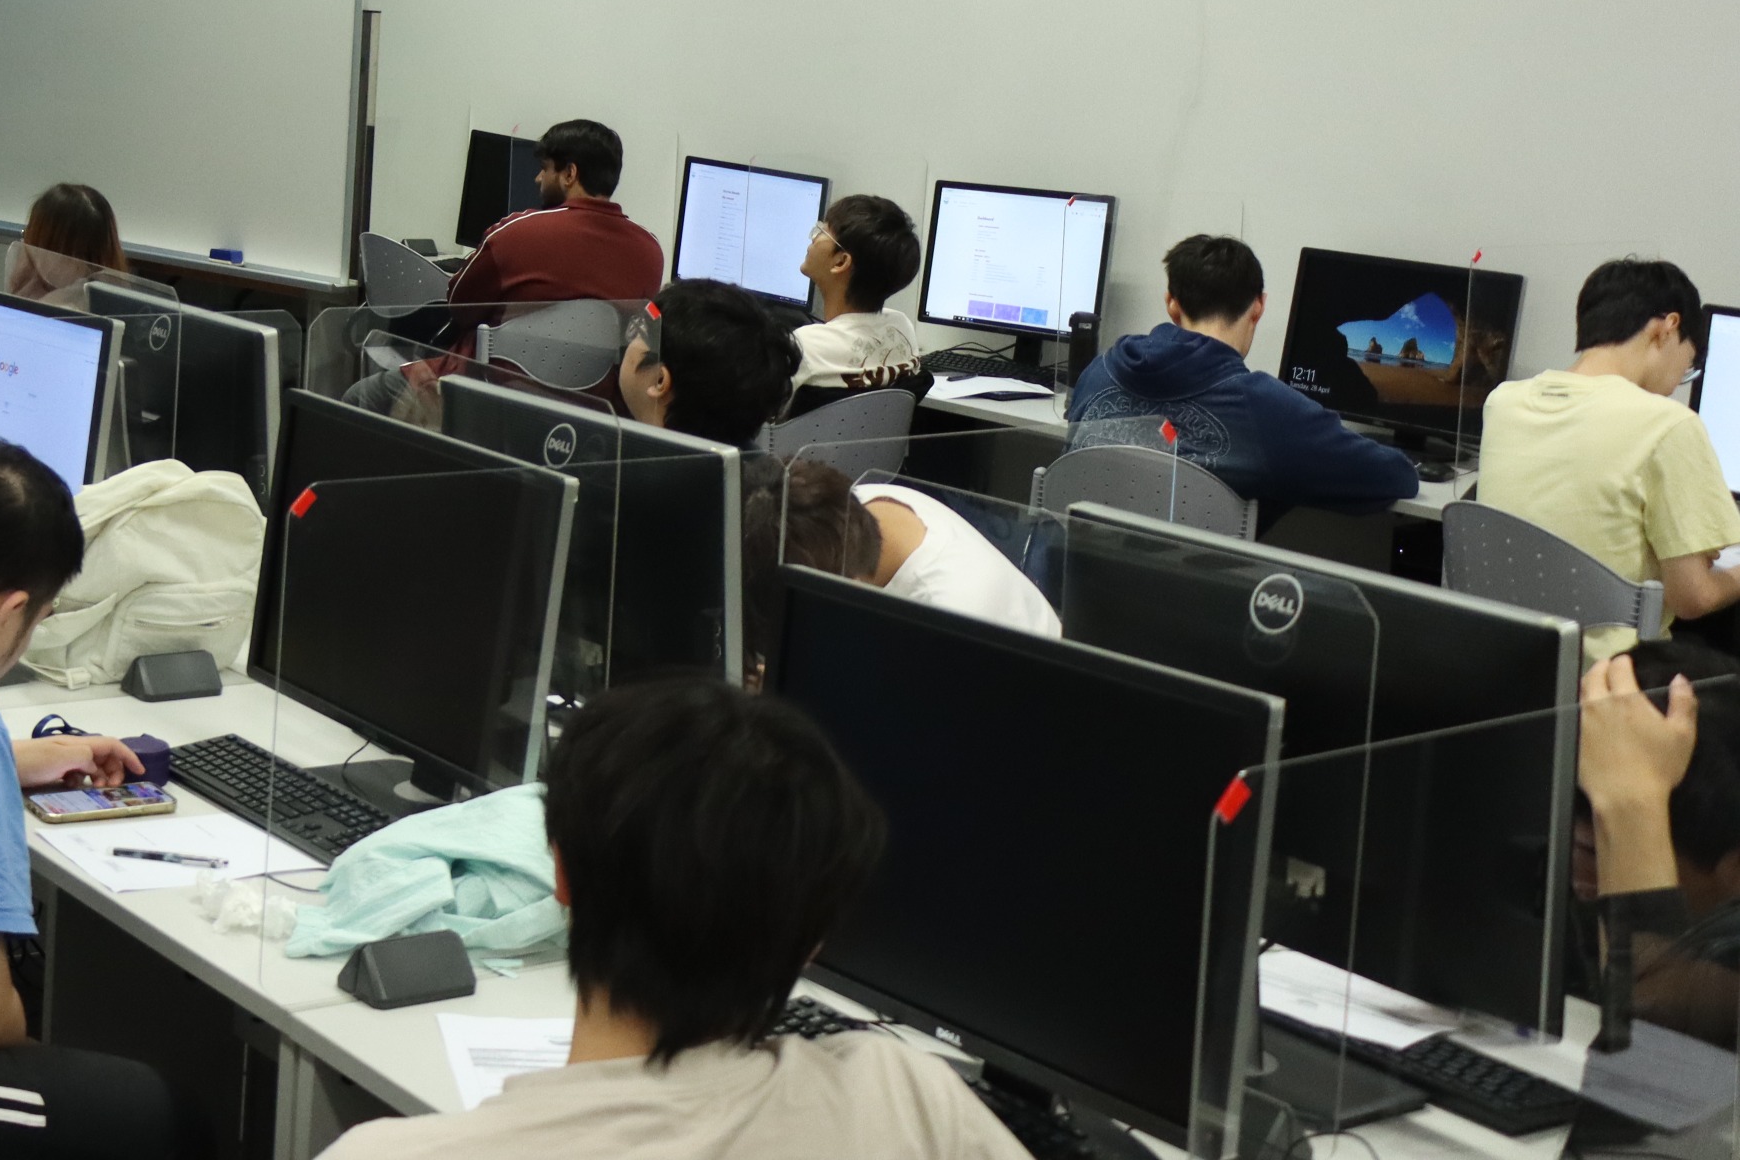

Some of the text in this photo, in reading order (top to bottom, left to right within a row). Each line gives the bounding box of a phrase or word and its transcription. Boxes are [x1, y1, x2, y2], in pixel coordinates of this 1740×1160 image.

[1292, 366, 1316, 382] 12:11
[1318, 386, 1331, 394] April
[935, 1026, 963, 1047] DELL
